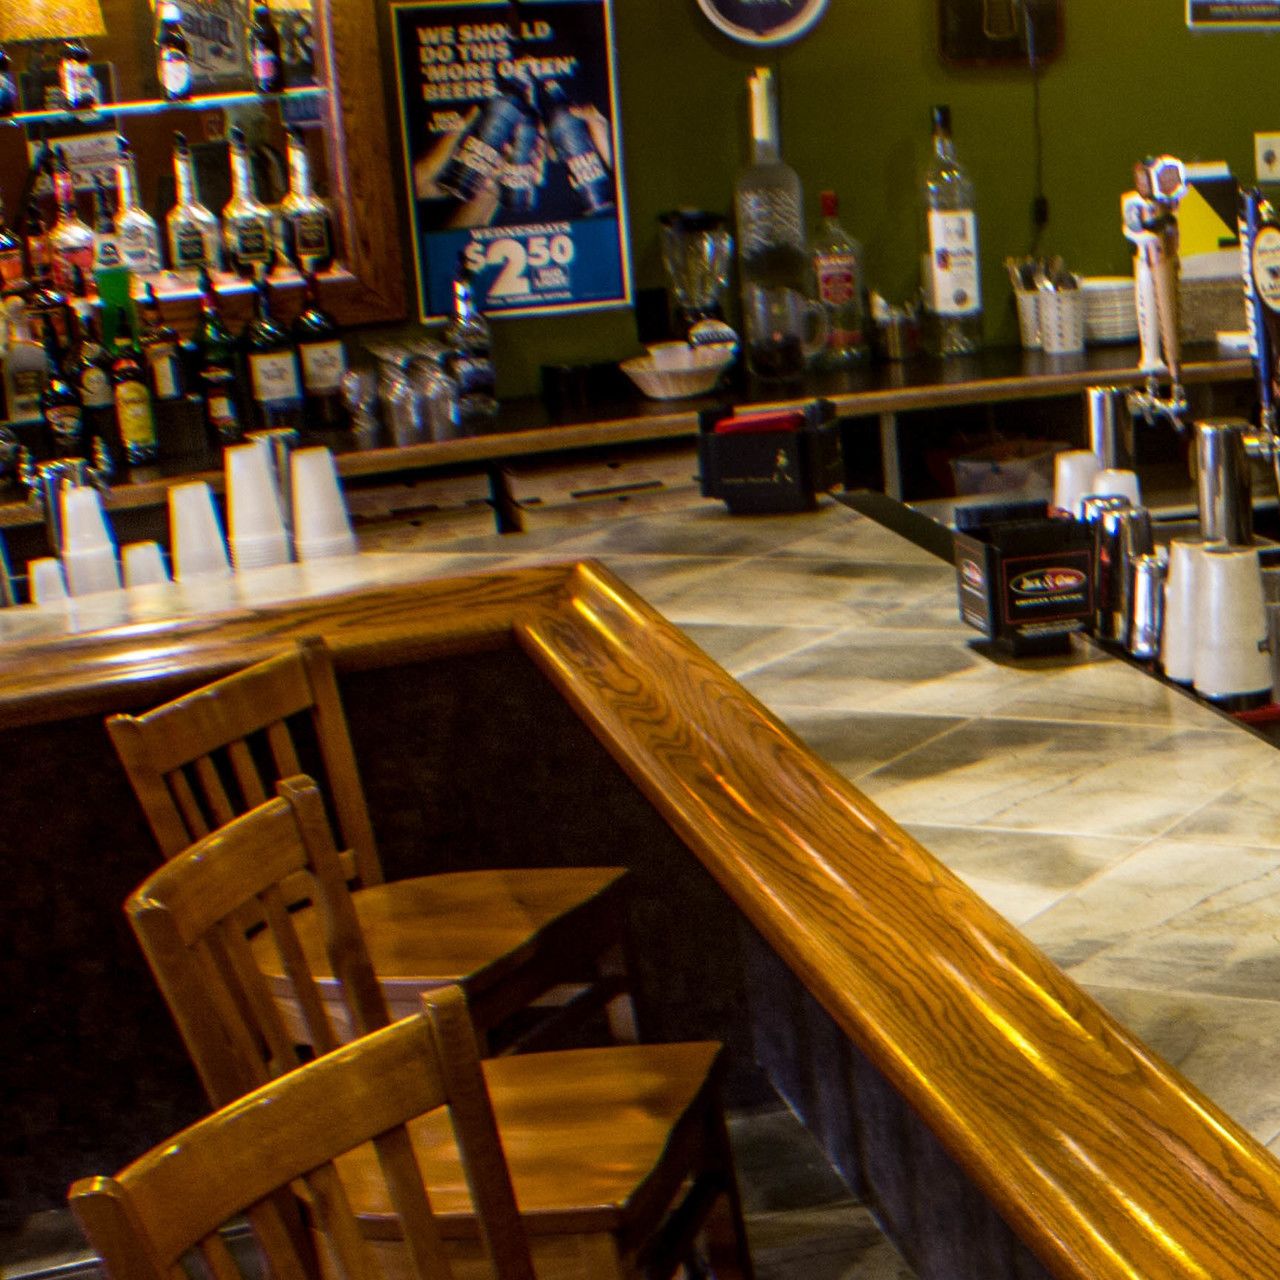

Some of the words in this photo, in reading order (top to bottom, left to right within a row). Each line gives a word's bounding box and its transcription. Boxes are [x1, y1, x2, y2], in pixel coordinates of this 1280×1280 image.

[416, 26, 455, 45] WE
[419, 45, 453, 64] DO
[455, 42, 511, 61] THIS
[422, 81, 498, 100] BEERS
